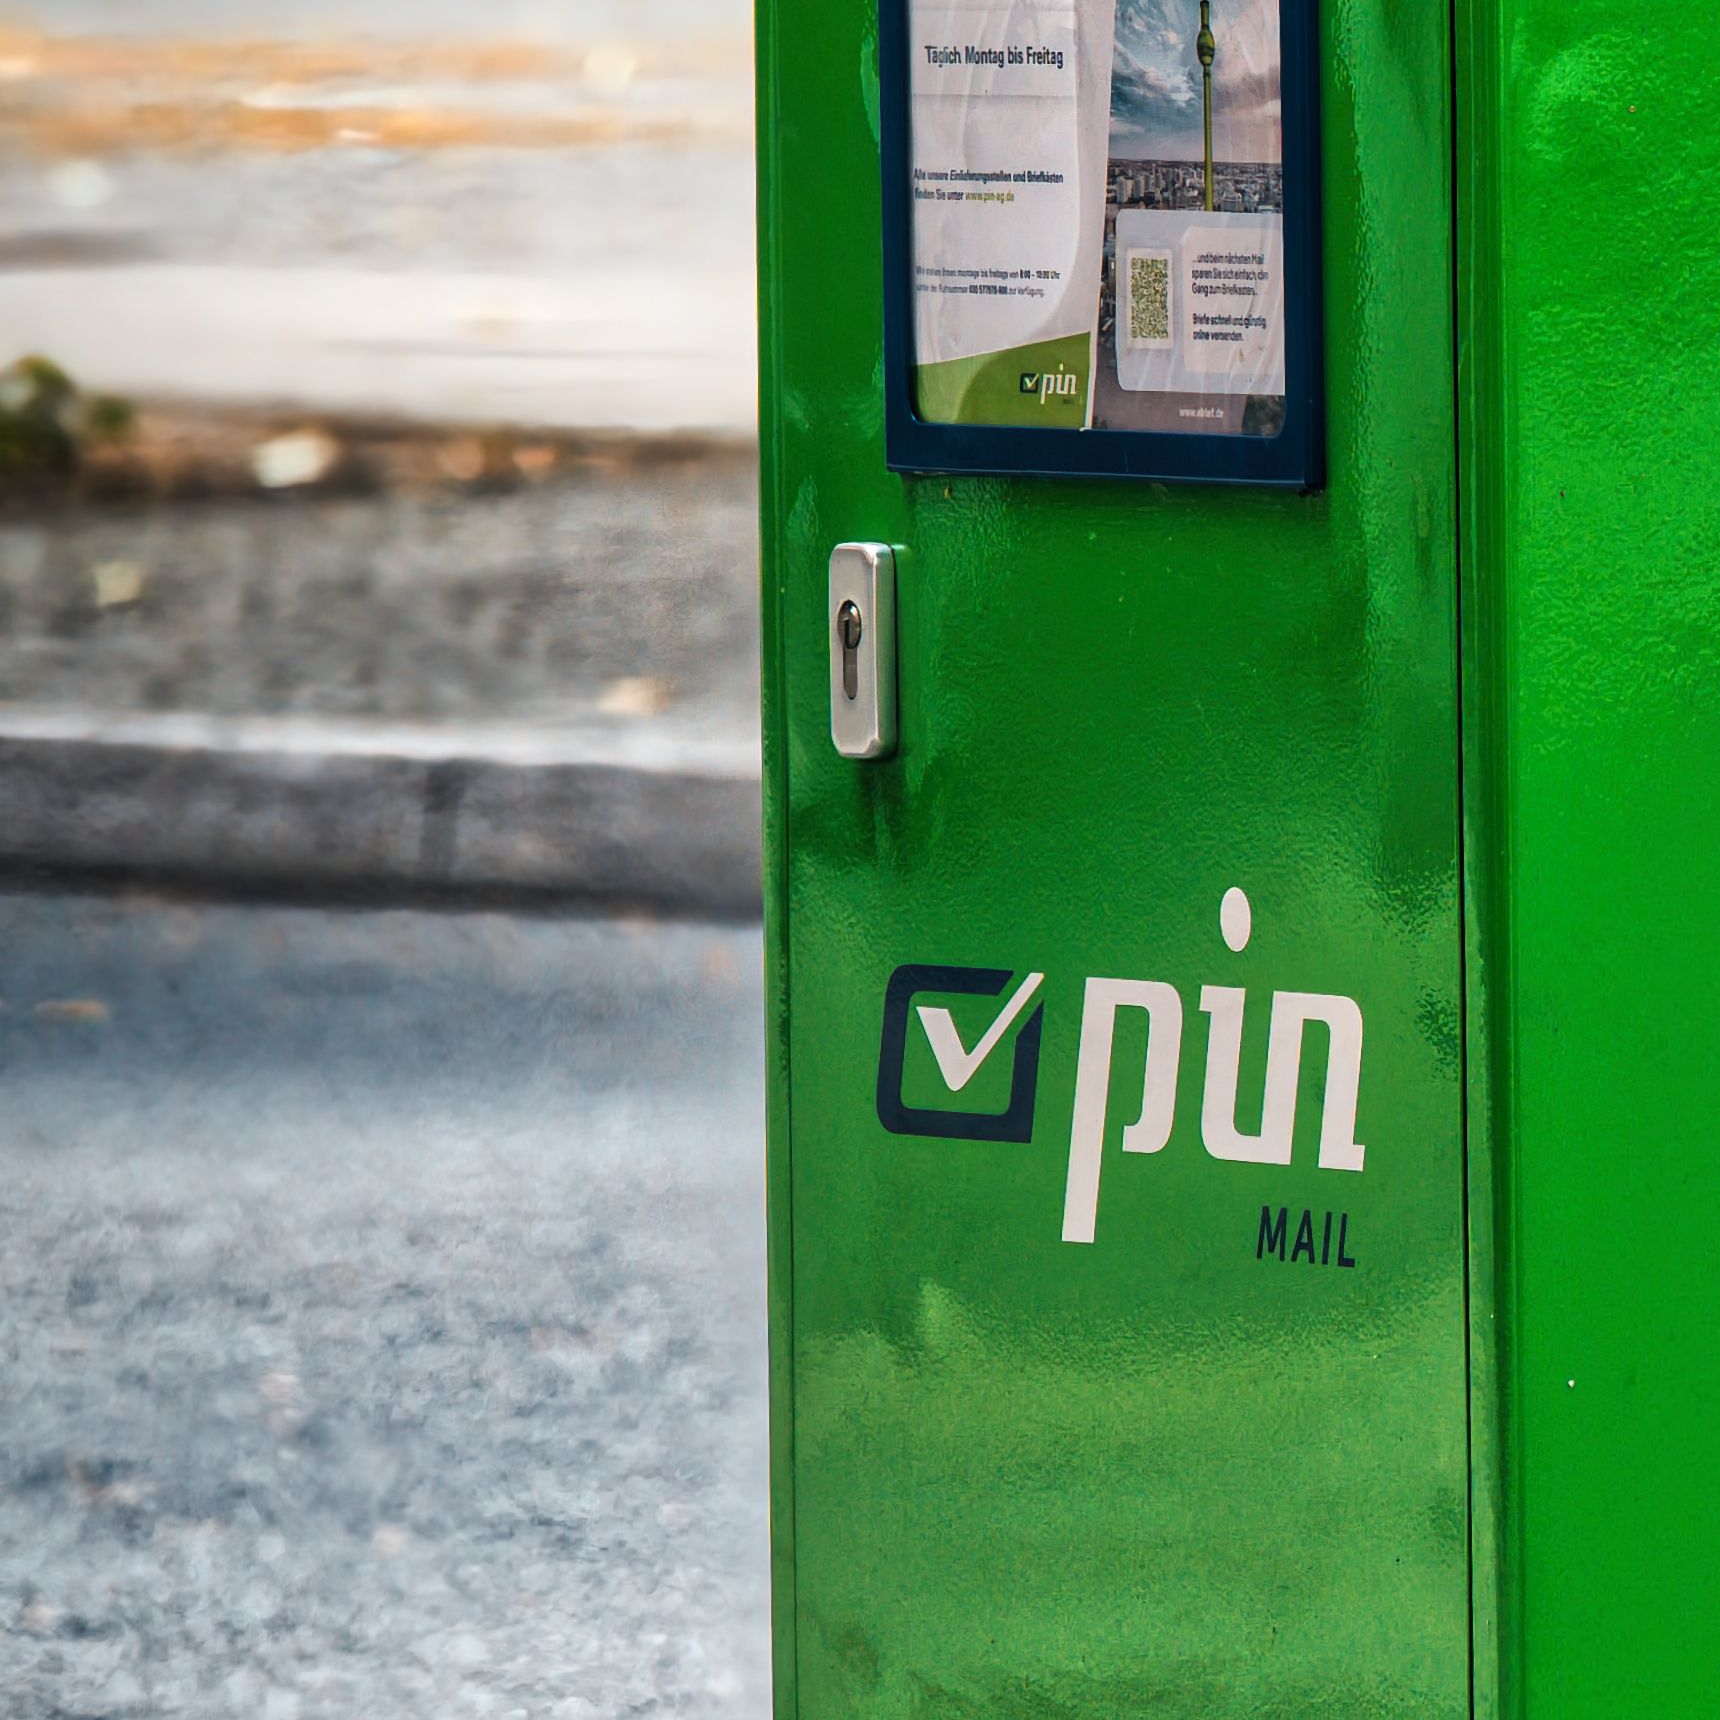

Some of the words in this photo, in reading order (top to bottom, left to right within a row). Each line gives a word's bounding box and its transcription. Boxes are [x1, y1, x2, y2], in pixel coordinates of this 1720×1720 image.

[965, 46, 1005, 68] Montag
[1008, 46, 1023, 64] bis
[1026, 46, 1063, 69] Freitag
[1013, 170, 1026, 182] und
[1040, 363, 1077, 404] pin
[1060, 886, 1365, 1244] pin
[1256, 1205, 1355, 1269] MAIL
